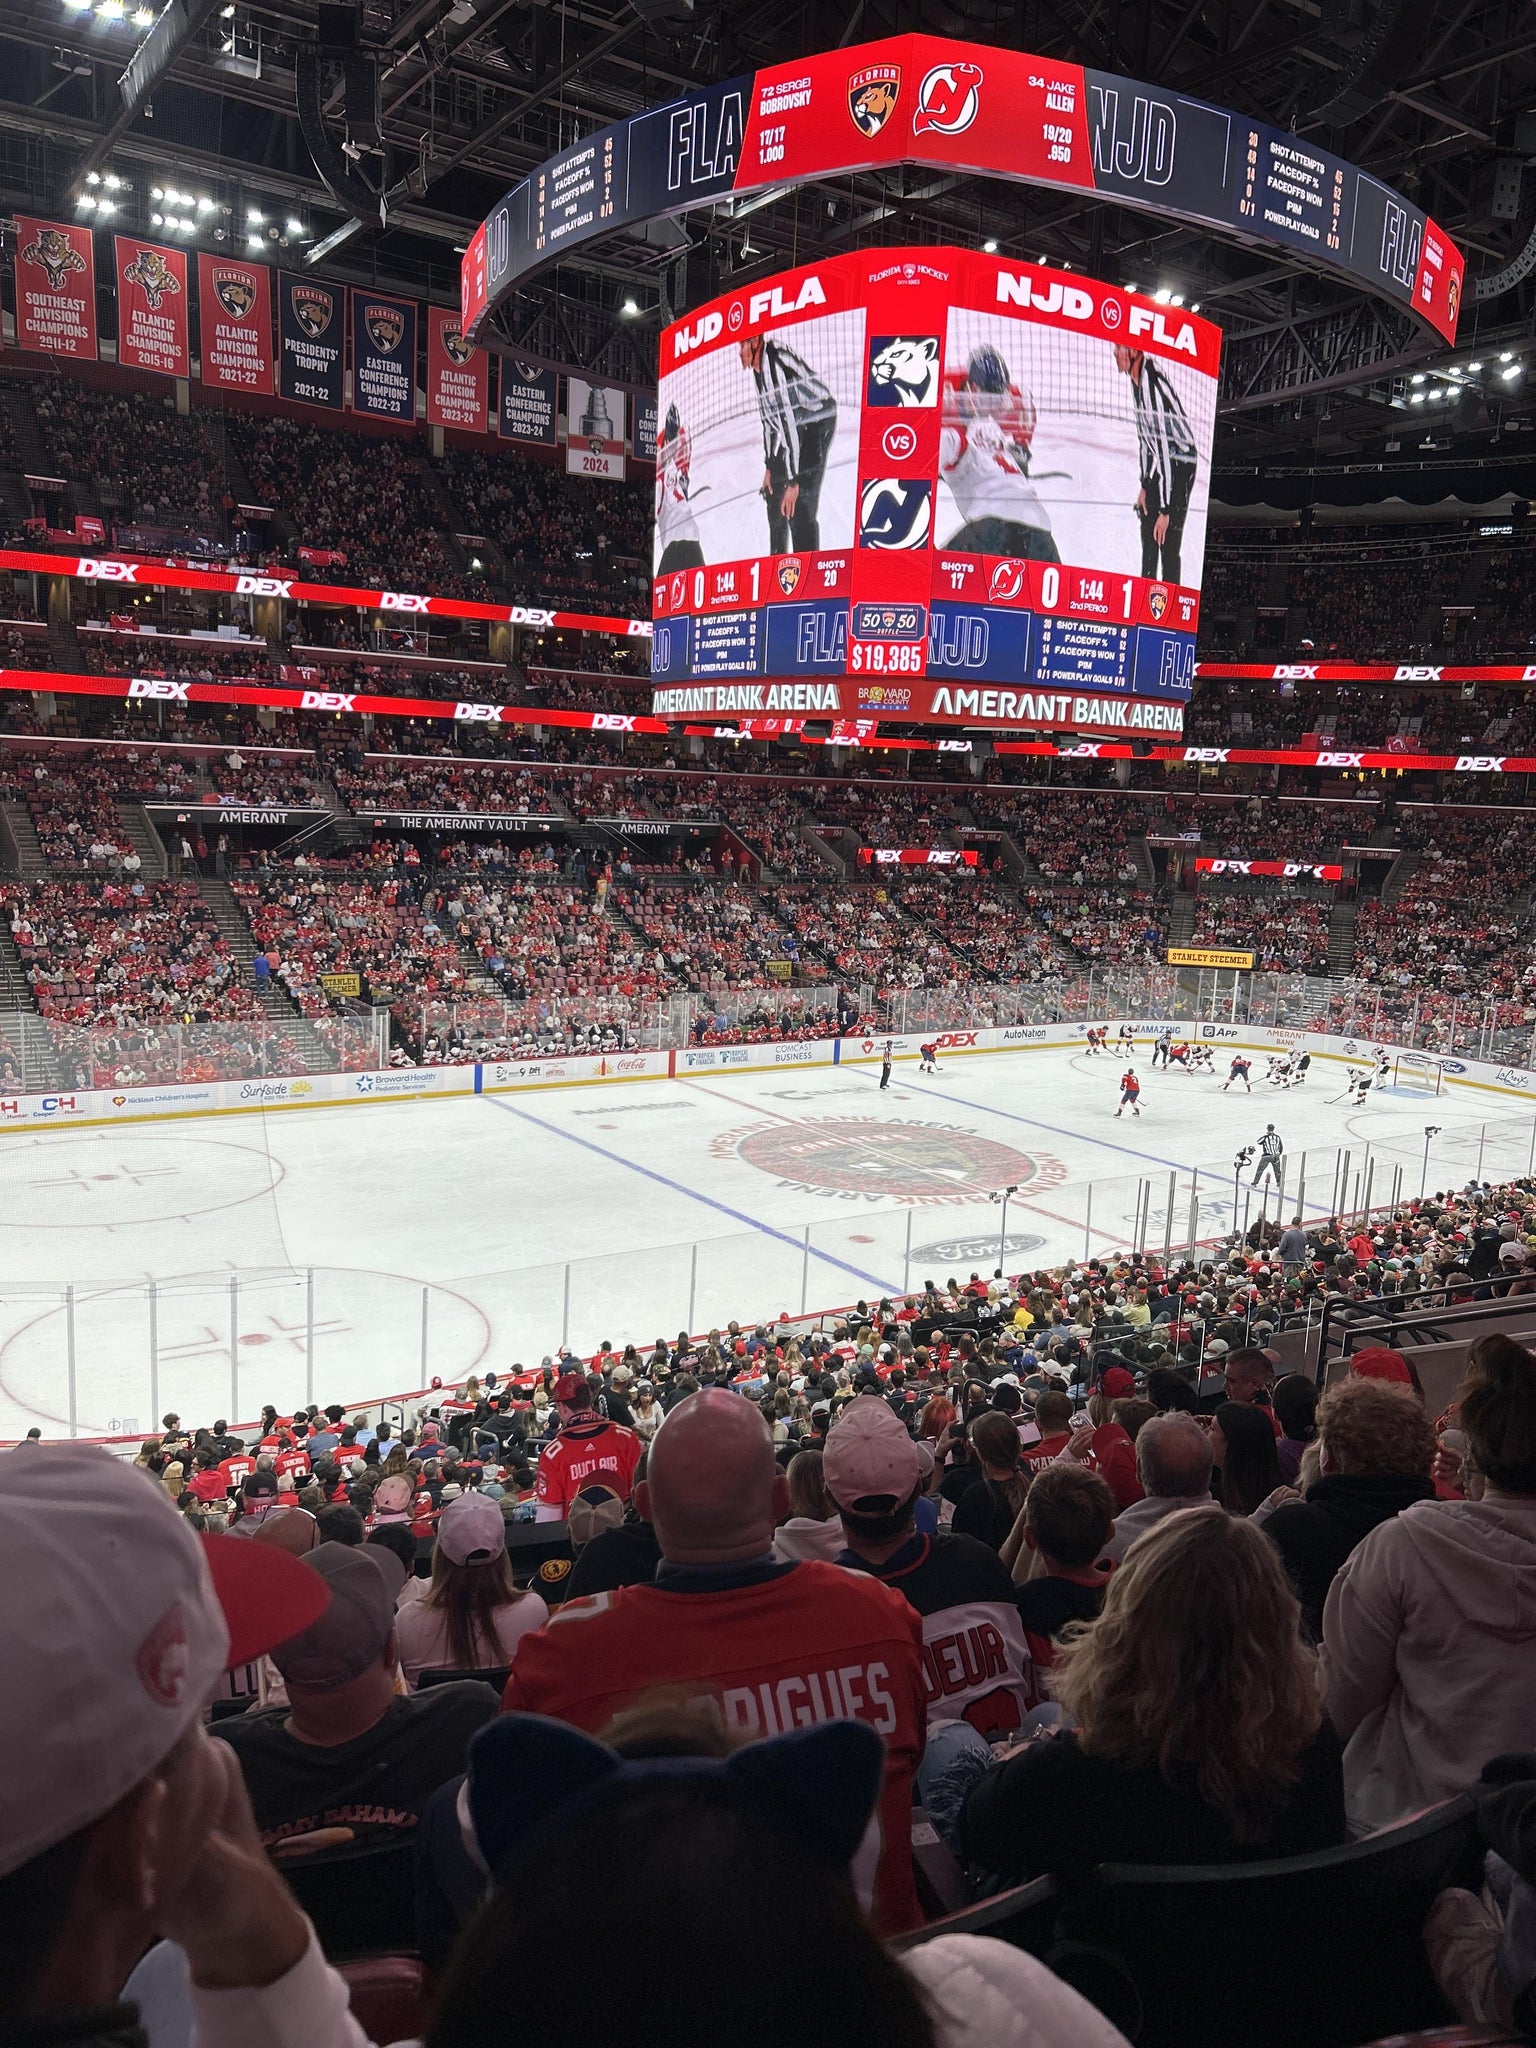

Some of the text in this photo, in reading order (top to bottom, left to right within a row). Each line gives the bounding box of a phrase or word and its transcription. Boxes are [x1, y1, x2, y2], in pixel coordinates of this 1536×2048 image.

[852, 68, 896, 88] FLORIDA
[1028, 76, 1076, 96] 34 JAKE
[761, 77, 811, 98] 72 SERGEI
[760, 89, 812, 117] BOBROVSKY
[1046, 92, 1074, 114] ALLEN
[759, 126, 785, 147] 17/17
[1042, 124, 1072, 144] 19/20
[1091, 86, 1176, 186] NJD
[759, 145, 784, 164] 1.000
[1048, 144, 1071, 164] .950
[1270, 142, 1325, 175] SHOT ATTEMPTS
[1273, 160, 1312, 185] FACEOFF
[1267, 176, 1306, 200] FACEOFFS
[216, 270, 252, 286] FLORIDA
[868, 264, 949, 282] FLORIDA HOCKEY
[25, 292, 86, 312] SOUTHEAST
[295, 289, 330, 304] FLORIDA
[34, 306, 80, 324] DIVISION
[131, 310, 176, 331] ATLANTIC
[368, 308, 400, 322] FLORIDA
[674, 276, 827, 358] NJD VS FLA
[996, 270, 1198, 357] NJD VS FLA
[26, 318, 88, 340] CHAMPIONS
[133, 323, 174, 344] DIVISION
[215, 324, 258, 342] ATLANTIC
[39, 335, 76, 352] 2011-12
[126, 334, 182, 358] CHAMPIONS
[216, 338, 258, 356] DIVISION
[284, 338, 338, 360] PRESIDENTS'
[138, 352, 174, 370] 2015-16
[210, 352, 265, 372] CHAMPIONS
[295, 354, 329, 374] TROPHY
[366, 357, 402, 374] EASTERN
[218, 368, 257, 384] 2021-22
[359, 369, 409, 389] CONFERENCE
[440, 370, 476, 386] ATLANTIC
[294, 382, 329, 400] 2021-22
[360, 382, 407, 400] CHAMPIONS
[441, 382, 475, 398] DIVISION
[512, 384, 545, 400] EASTERN
[367, 396, 400, 412] 2022-23
[435, 394, 480, 412] CHAMPIONS
[505, 396, 552, 414] CONFERENCE
[442, 410, 474, 424] 2023-24
[506, 408, 550, 426] CHAMPIONS
[512, 422, 544, 437] 2023-24
[889, 436, 910, 450] VS
[583, 456, 610, 473] 2024
[77, 558, 140, 582] DEX
[817, 560, 846, 570] SHOTS
[941, 562, 974, 573] SHOTS
[236, 576, 294, 598] DEX
[716, 571, 735, 593] 1:44
[750, 562, 759, 602] 1
[824, 570, 836, 587] 20
[950, 572, 964, 590] 17
[1041, 567, 1060, 608] 0
[694, 570, 704, 608] 0
[1079, 578, 1104, 600] 1:44
[380, 592, 432, 614] DEX
[1084, 603, 1108, 613] PERIOD
[1122, 580, 1132, 618] 1
[510, 607, 558, 626] DEX
[862, 613, 916, 628] 50 50
[1056, 620, 1117, 636] SHOT ATTEMPTS
[1064, 634, 1101, 646] FACEOFF
[852, 644, 922, 674] $19,385
[1054, 646, 1096, 658] FACEOFFS
[1078, 661, 1092, 670] PIM
[1272, 666, 1319, 680] DEX
[1394, 666, 1444, 681] DEX
[1092, 675, 1113, 684] GOALS
[128, 678, 191, 700] DEX
[300, 691, 357, 712] DEX
[653, 683, 840, 714] AMERANT BANK ARENA
[455, 702, 505, 722] DEX
[930, 687, 1184, 731] AMERANT BANK ARENA
[592, 712, 638, 731] DEX
[1184, 748, 1232, 762] DEX
[1316, 752, 1365, 768] DEX
[1454, 756, 1506, 772] DEX
[219, 812, 288, 824] AMERANT
[400, 817, 528, 831] THE AMERANT VAULT
[620, 824, 671, 835] AMERANT
[1172, 952, 1248, 964] STANLEY STEEMER
[324, 978, 356, 986] STANLEY
[940, 1032, 979, 1048] DEX
[1004, 1028, 1046, 1040] AutoNation
[1266, 1029, 1306, 1040] AMERANT
[1276, 1038, 1295, 1047] BANK
[776, 1043, 812, 1054] COMCAST
[776, 1052, 812, 1062] BUSINESS
[376, 1073, 436, 1084] Broward Health
[155, 1093, 184, 1102] Children's
[186, 1092, 209, 1100] Hospital
[240, 1083, 287, 1099] Surfside
[42, 1096, 76, 1111] CH
[708, 1120, 780, 1160] AMERANT
[886, 1118, 978, 1134] ARENA
[936, 1239, 1020, 1260] Ford
[570, 1456, 618, 1480] DUCLAIR
